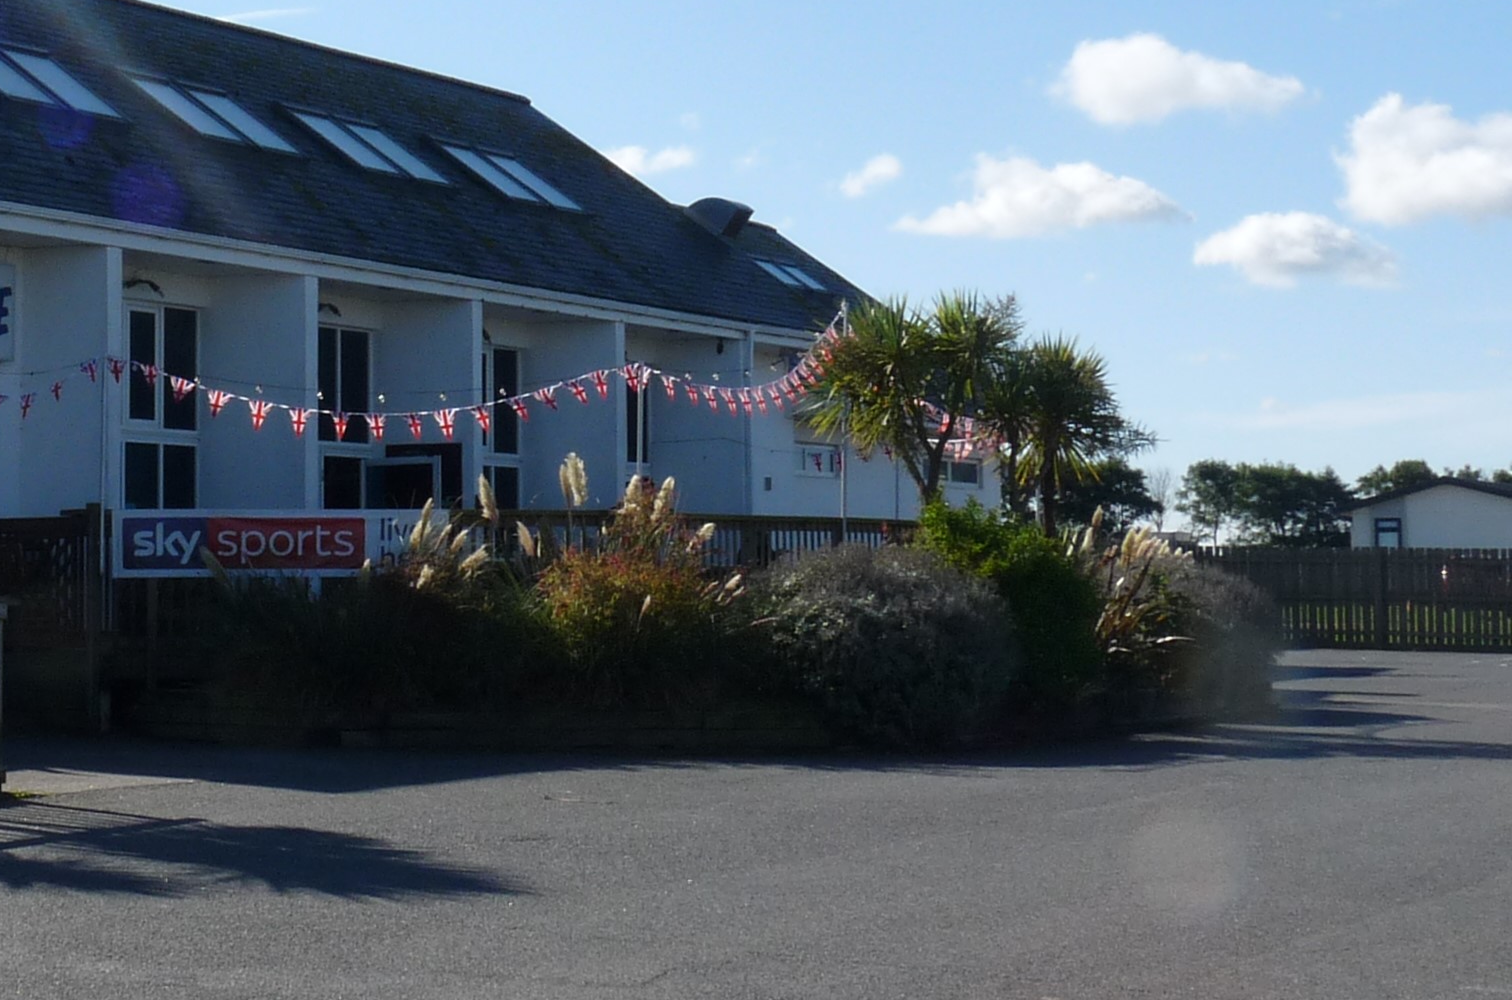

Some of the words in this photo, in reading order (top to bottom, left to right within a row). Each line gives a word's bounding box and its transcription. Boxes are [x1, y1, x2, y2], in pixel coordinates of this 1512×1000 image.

[133, 522, 202, 562] sky
[217, 526, 355, 564] sports
[380, 517, 416, 541] liv
